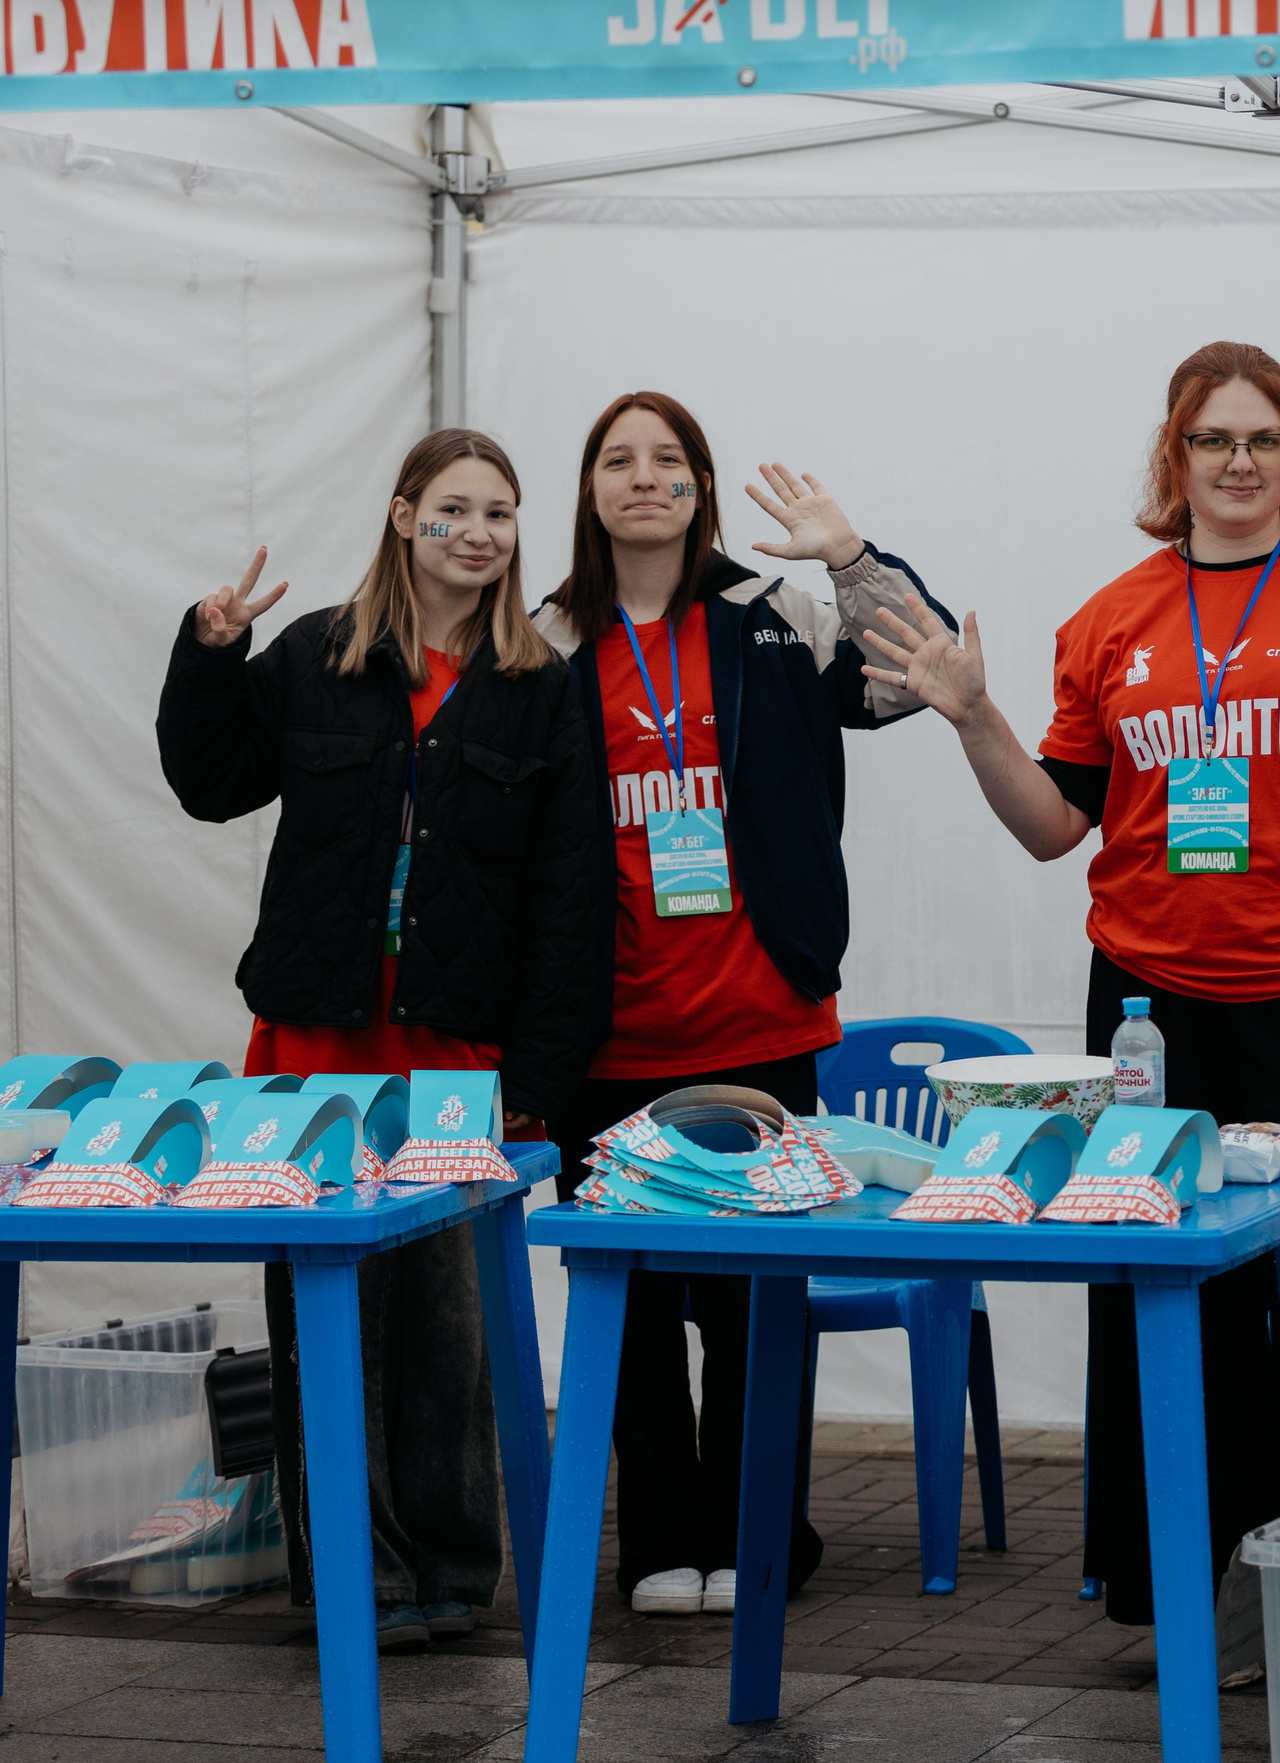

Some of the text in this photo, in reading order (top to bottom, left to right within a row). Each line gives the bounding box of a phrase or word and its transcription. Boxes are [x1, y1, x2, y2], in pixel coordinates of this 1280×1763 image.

[1181, 852, 1236, 871] КОМАНДА
[667, 893, 720, 913] КОМАНДА
[442, 1148, 467, 1157] БЕГ
[469, 1148, 479, 1157] В
[443, 1170, 470, 1181] БЕГ
[472, 1171, 483, 1180] В
[59, 1195, 87, 1205] БЕГ
[220, 1195, 249, 1205] БЕГ
